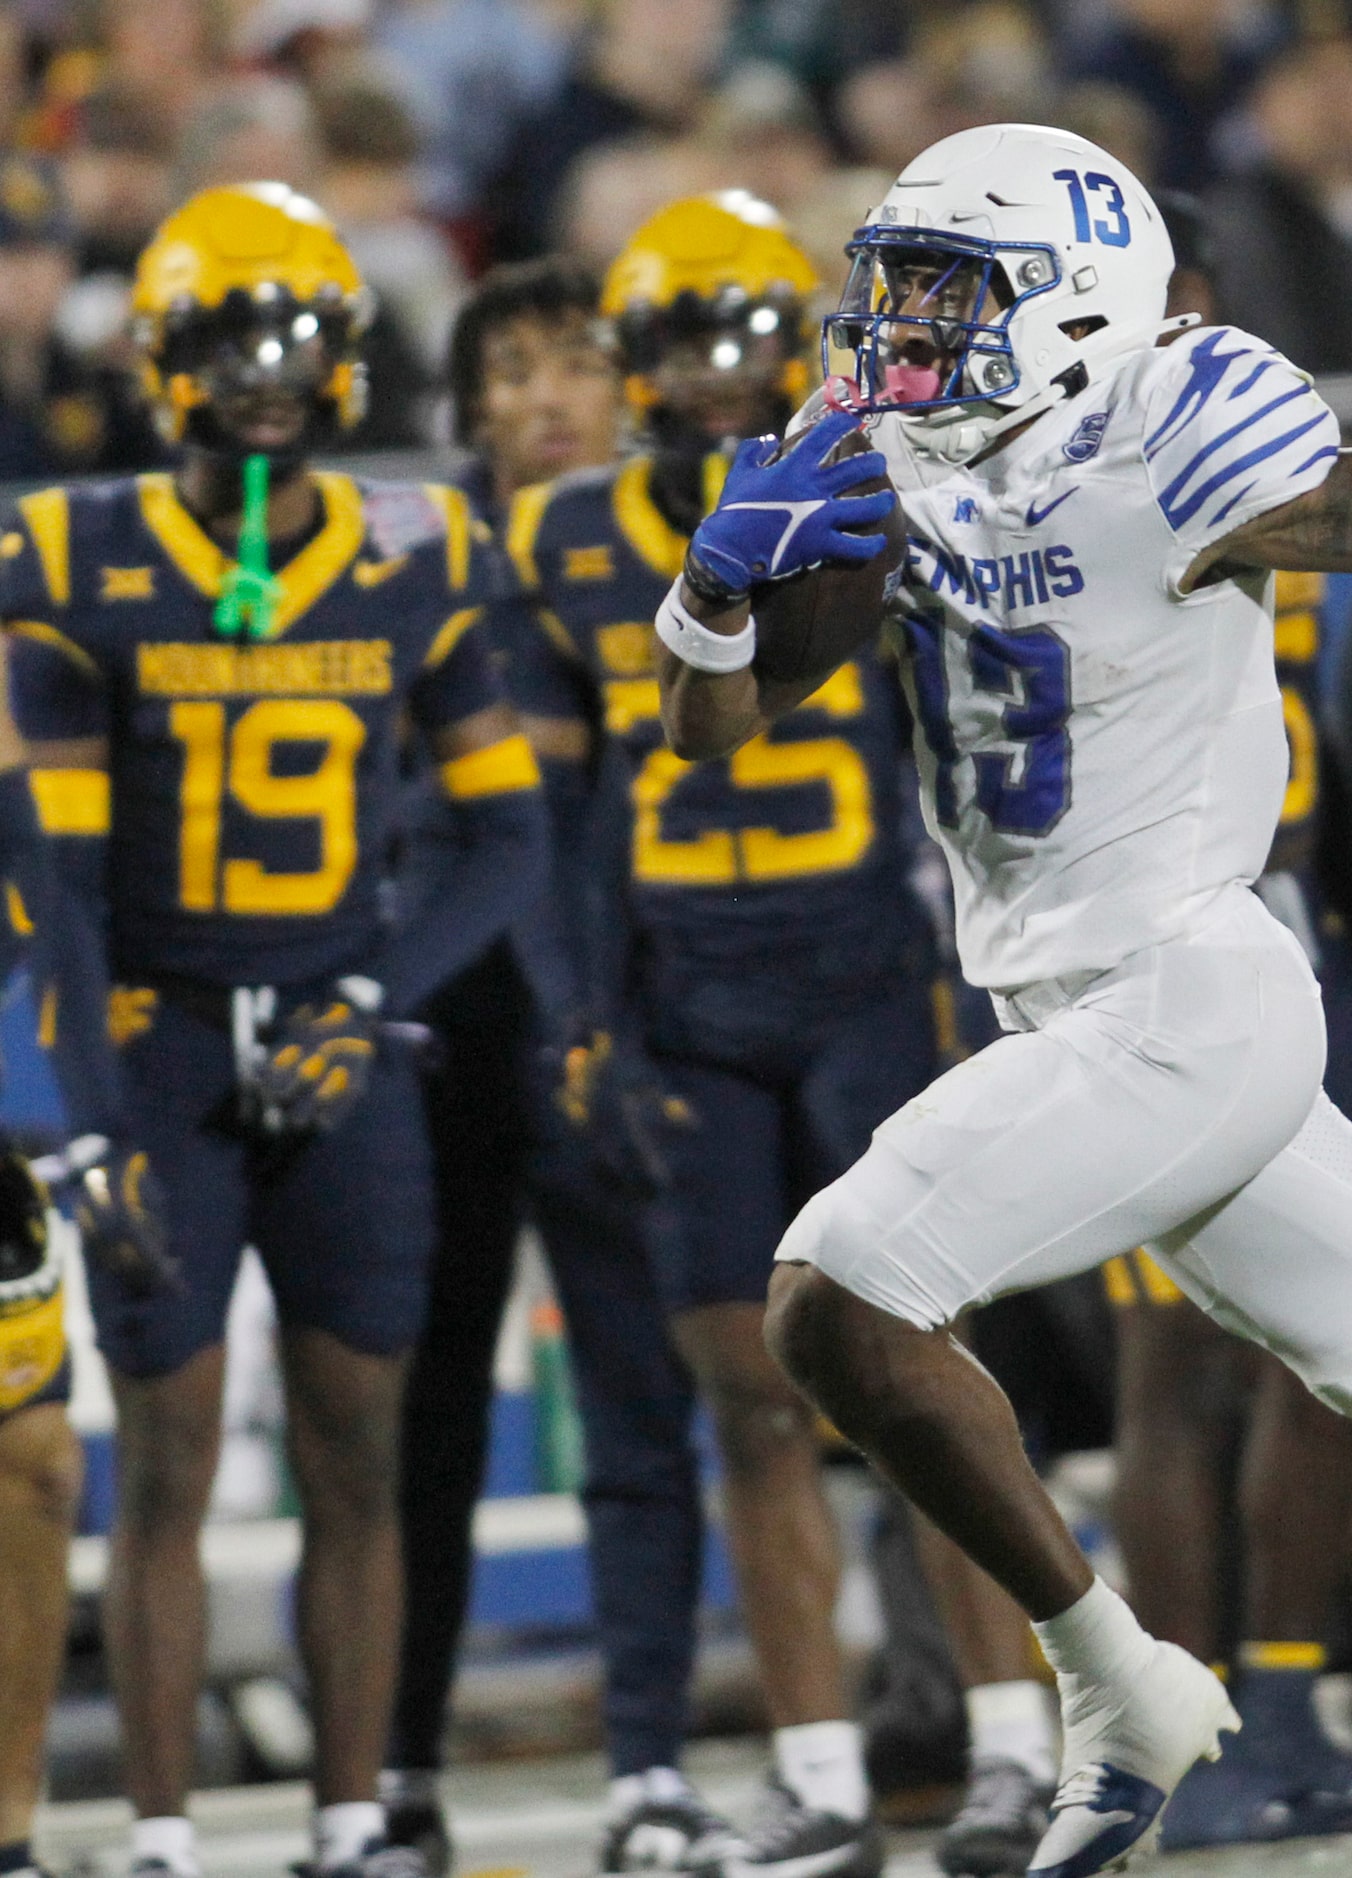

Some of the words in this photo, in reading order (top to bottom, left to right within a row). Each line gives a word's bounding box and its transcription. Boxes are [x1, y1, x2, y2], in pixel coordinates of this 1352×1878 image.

[1052, 168, 1131, 248] 13
[170, 700, 366, 914] 19
[603, 660, 876, 884] 25
[904, 610, 1074, 838] 13
